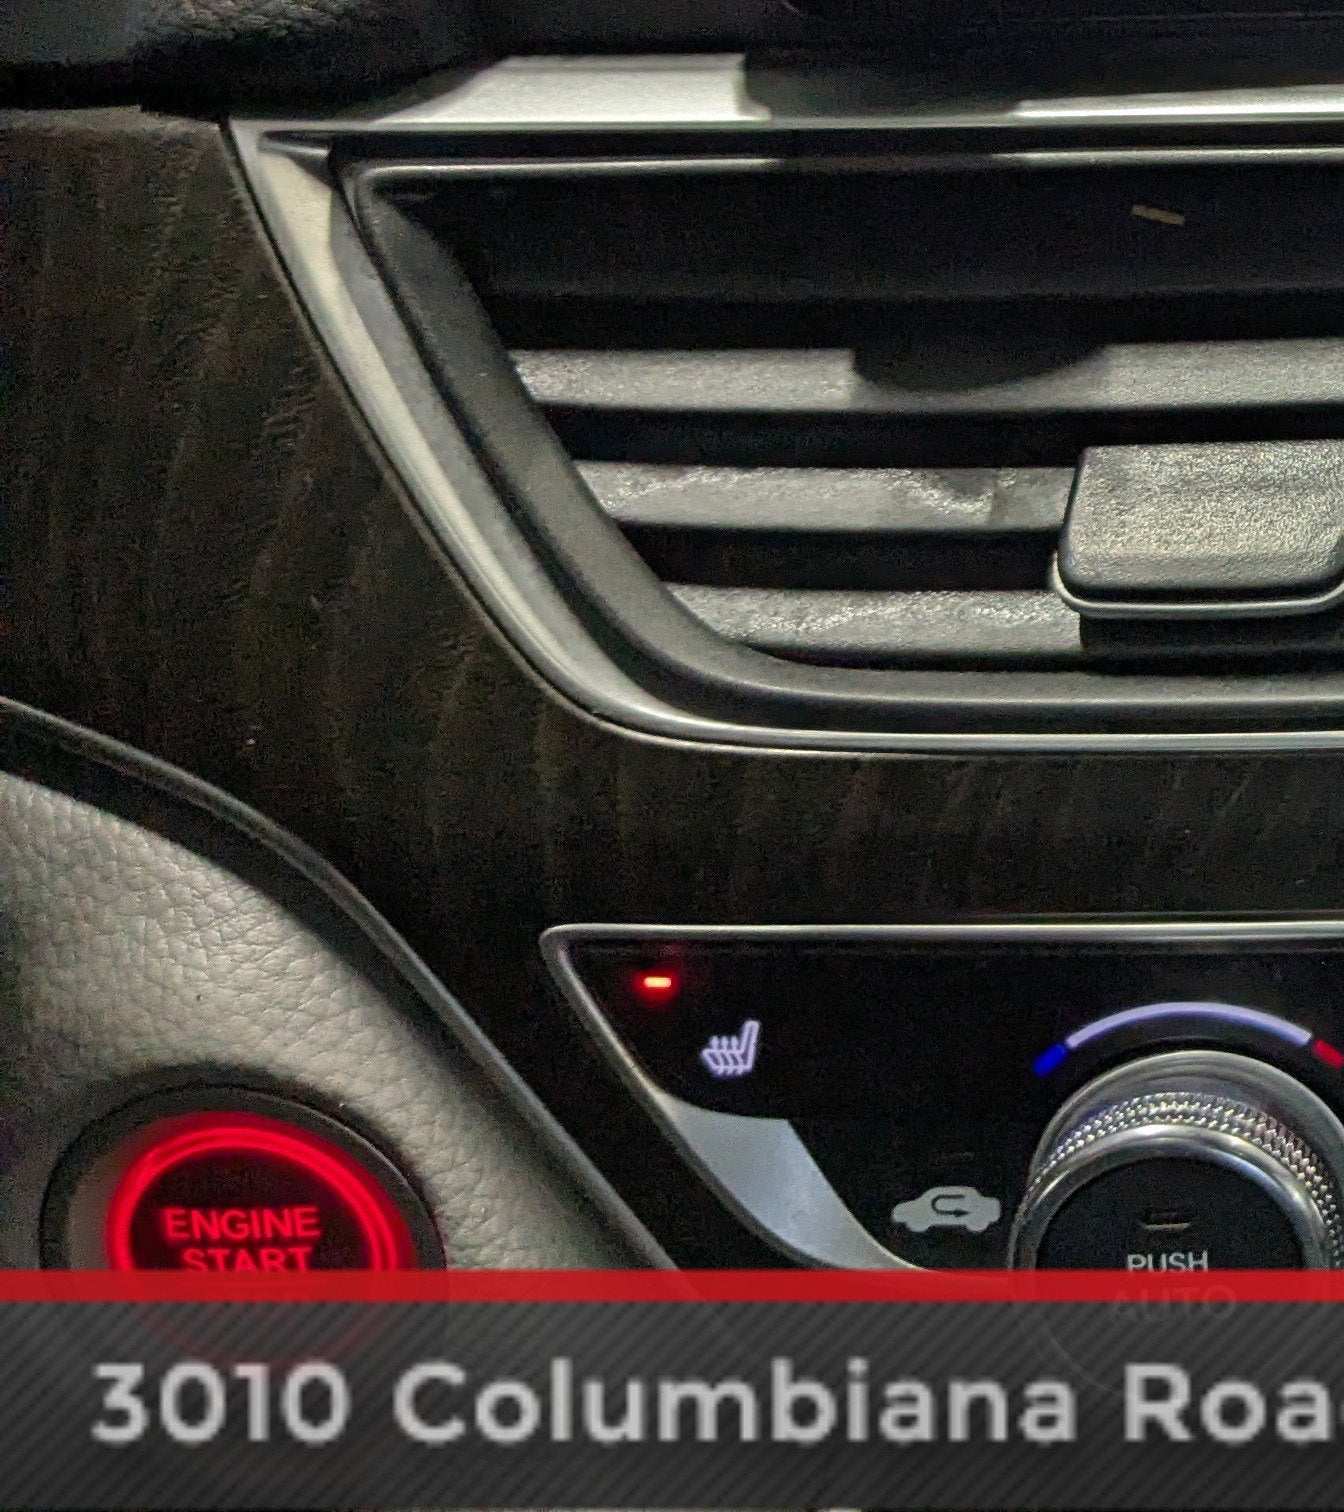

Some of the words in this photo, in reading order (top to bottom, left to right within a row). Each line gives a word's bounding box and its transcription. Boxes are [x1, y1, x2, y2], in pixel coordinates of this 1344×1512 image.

[163, 1206, 321, 1241] ENGINE
[182, 1247, 313, 1272] START
[1126, 1251, 1209, 1276] PUSH
